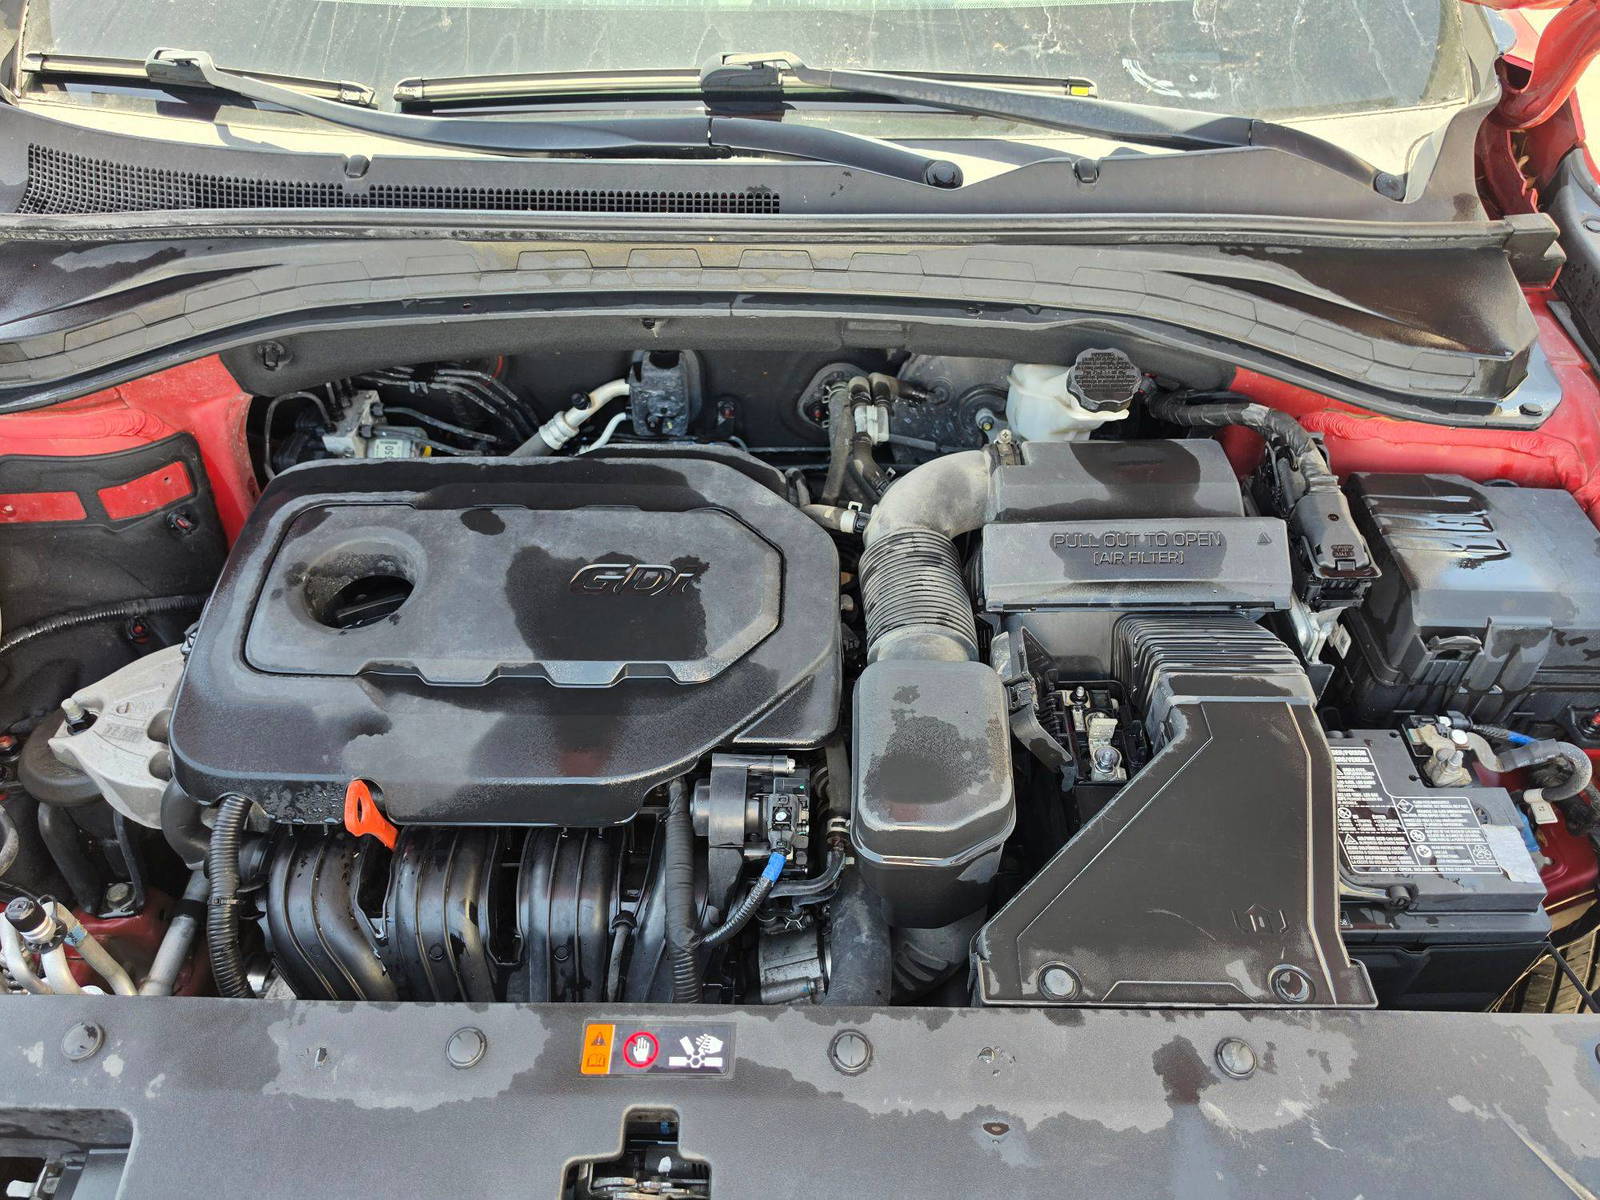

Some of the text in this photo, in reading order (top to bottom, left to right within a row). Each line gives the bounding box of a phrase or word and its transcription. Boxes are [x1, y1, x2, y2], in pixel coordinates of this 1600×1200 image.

[1053, 531, 1222, 548] PULL OUT TO OPEN
